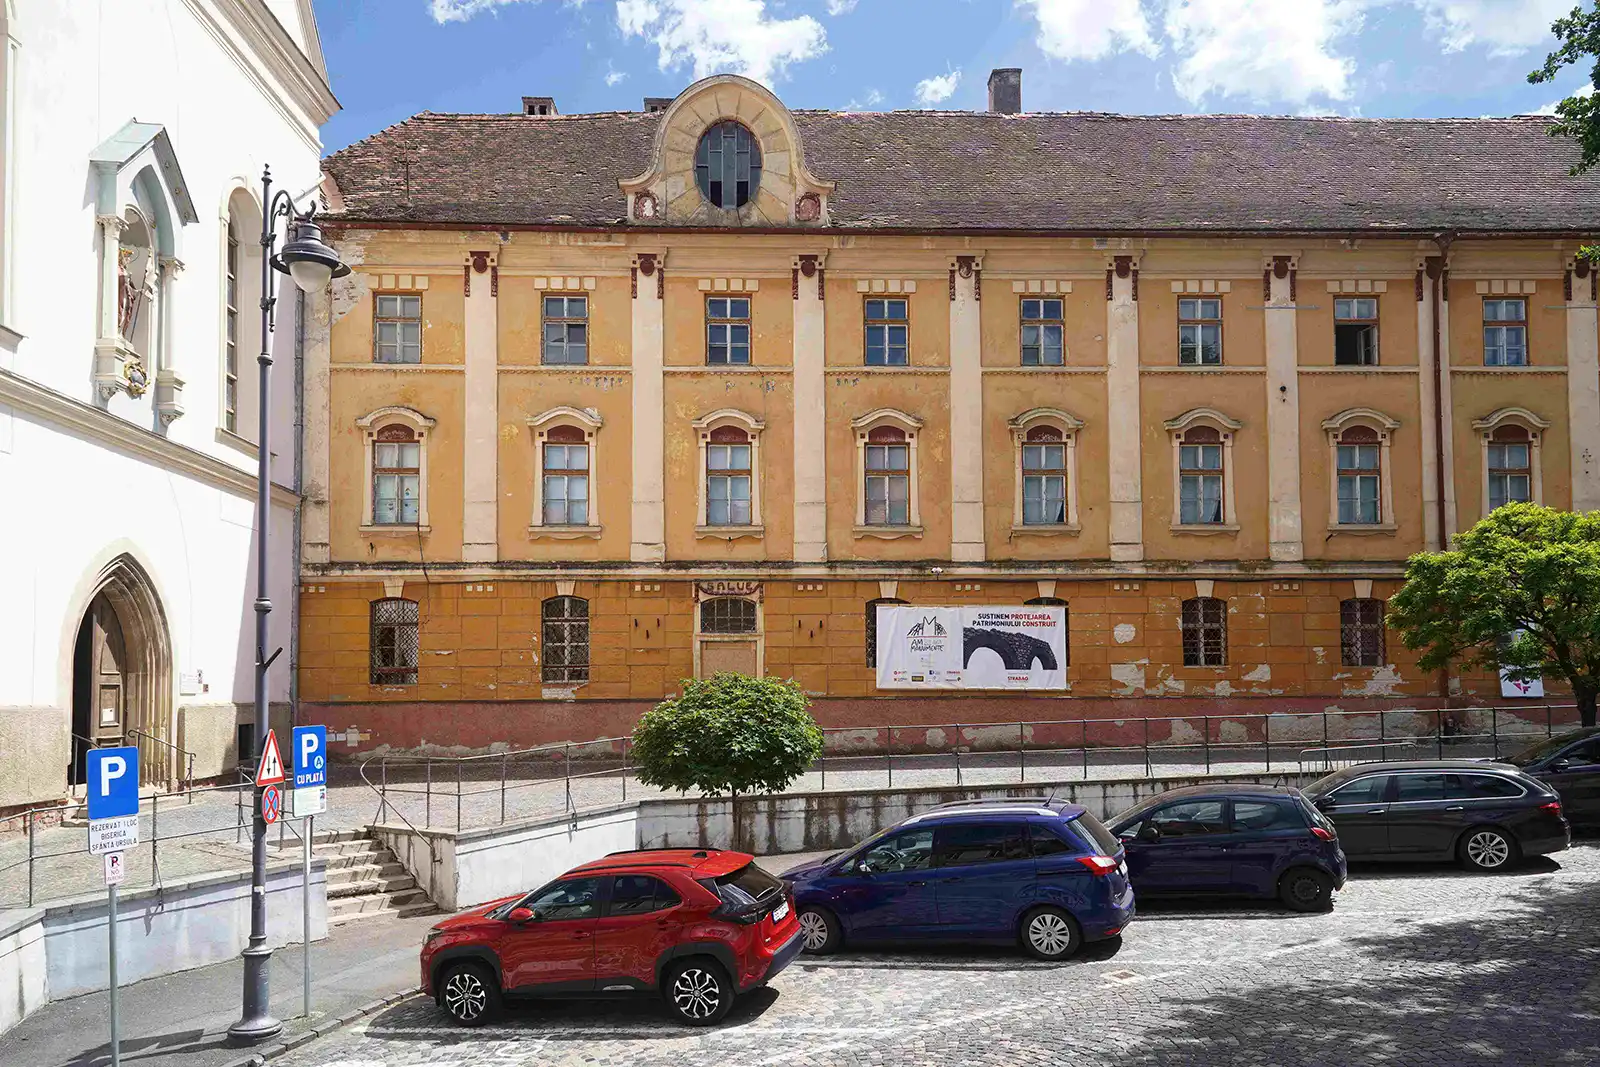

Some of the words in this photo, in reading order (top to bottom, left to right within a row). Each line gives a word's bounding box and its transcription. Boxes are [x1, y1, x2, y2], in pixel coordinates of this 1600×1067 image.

[1021, 620, 1057, 628] CONSTRUIT
[301, 733, 319, 768] P
[100, 755, 127, 797] P
[296, 774, 305, 785] CU
[91, 821, 121, 833] REZERVAT
[126, 818, 138, 828] LOC
[100, 829, 127, 841] BISERICA
[115, 837, 137, 848] URSULA
